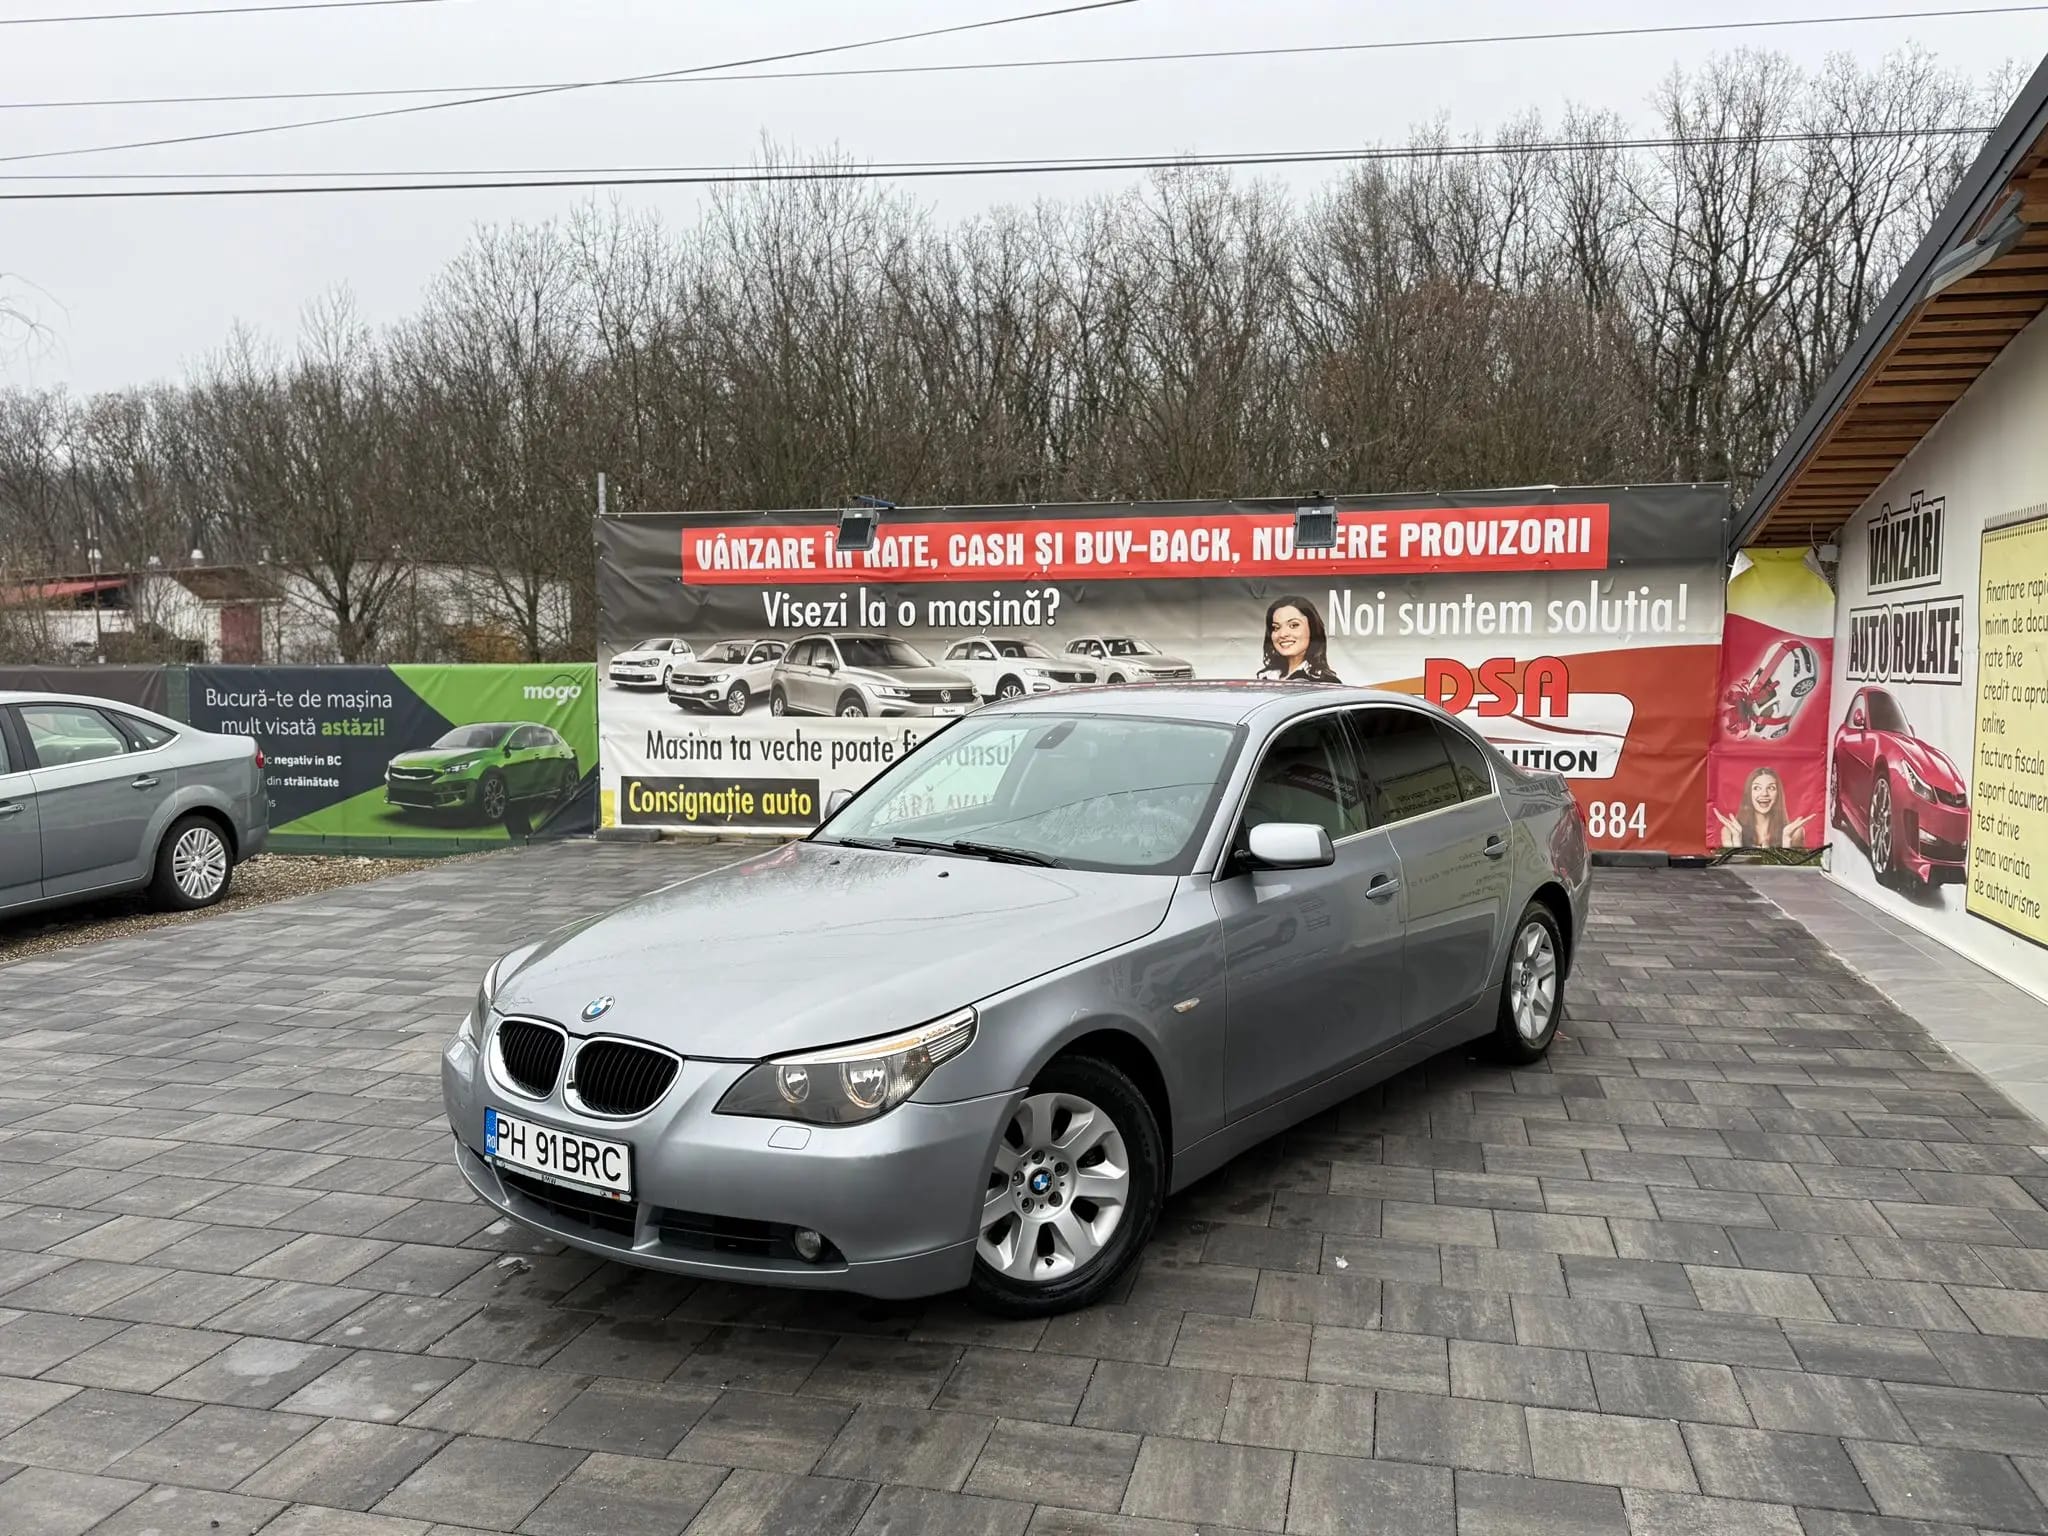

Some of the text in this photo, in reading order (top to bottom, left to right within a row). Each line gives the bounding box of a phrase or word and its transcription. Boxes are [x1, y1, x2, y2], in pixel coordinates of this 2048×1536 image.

[696, 532, 816, 570] VÂNZARE
[863, 535, 939, 570] RATE,
[949, 532, 1024, 567] CASH
[1035, 532, 1063, 574] ȘI
[1075, 528, 1241, 564] BUY-BACK,
[1400, 517, 1592, 558] PROVIZORII
[1869, 501, 1942, 586] VÂNZĂRI
[1986, 579, 2025, 604] finantare
[762, 587, 1061, 635] Visezi la o mașină?
[1328, 580, 1688, 644] Noi suntem soluția!
[1985, 613, 2010, 636] minim
[2011, 609, 2023, 634] de
[1850, 606, 1960, 675] AUTO RULATE
[1984, 644, 2023, 671] rate fixe
[206, 688, 392, 713] Bucură-te de mașina
[523, 686, 582, 706] mogo
[1425, 656, 1570, 718] DSA
[1983, 677, 2010, 702] credit
[2011, 684, 2022, 702] cu
[221, 716, 386, 737] mult visată astăzi!
[1981, 710, 2006, 735] online
[274, 754, 313, 768] negativ
[327, 755, 342, 767] BC
[645, 730, 722, 761] Masina
[730, 735, 751, 761] ta
[759, 728, 822, 762] veche
[831, 736, 894, 770] poate
[1980, 742, 2045, 777] factura fiscala
[266, 775, 340, 788] din străinătate
[1978, 780, 2006, 806] suport
[628, 781, 812, 822] Consignație auto
[1588, 800, 1647, 839] 884
[1976, 808, 2020, 841] test drive
[1974, 846, 2031, 880] gama variata
[1973, 875, 2041, 919] de autoturisme
[486, 1133, 496, 1149] RO
[496, 1118, 622, 1182] PH 91BRC
